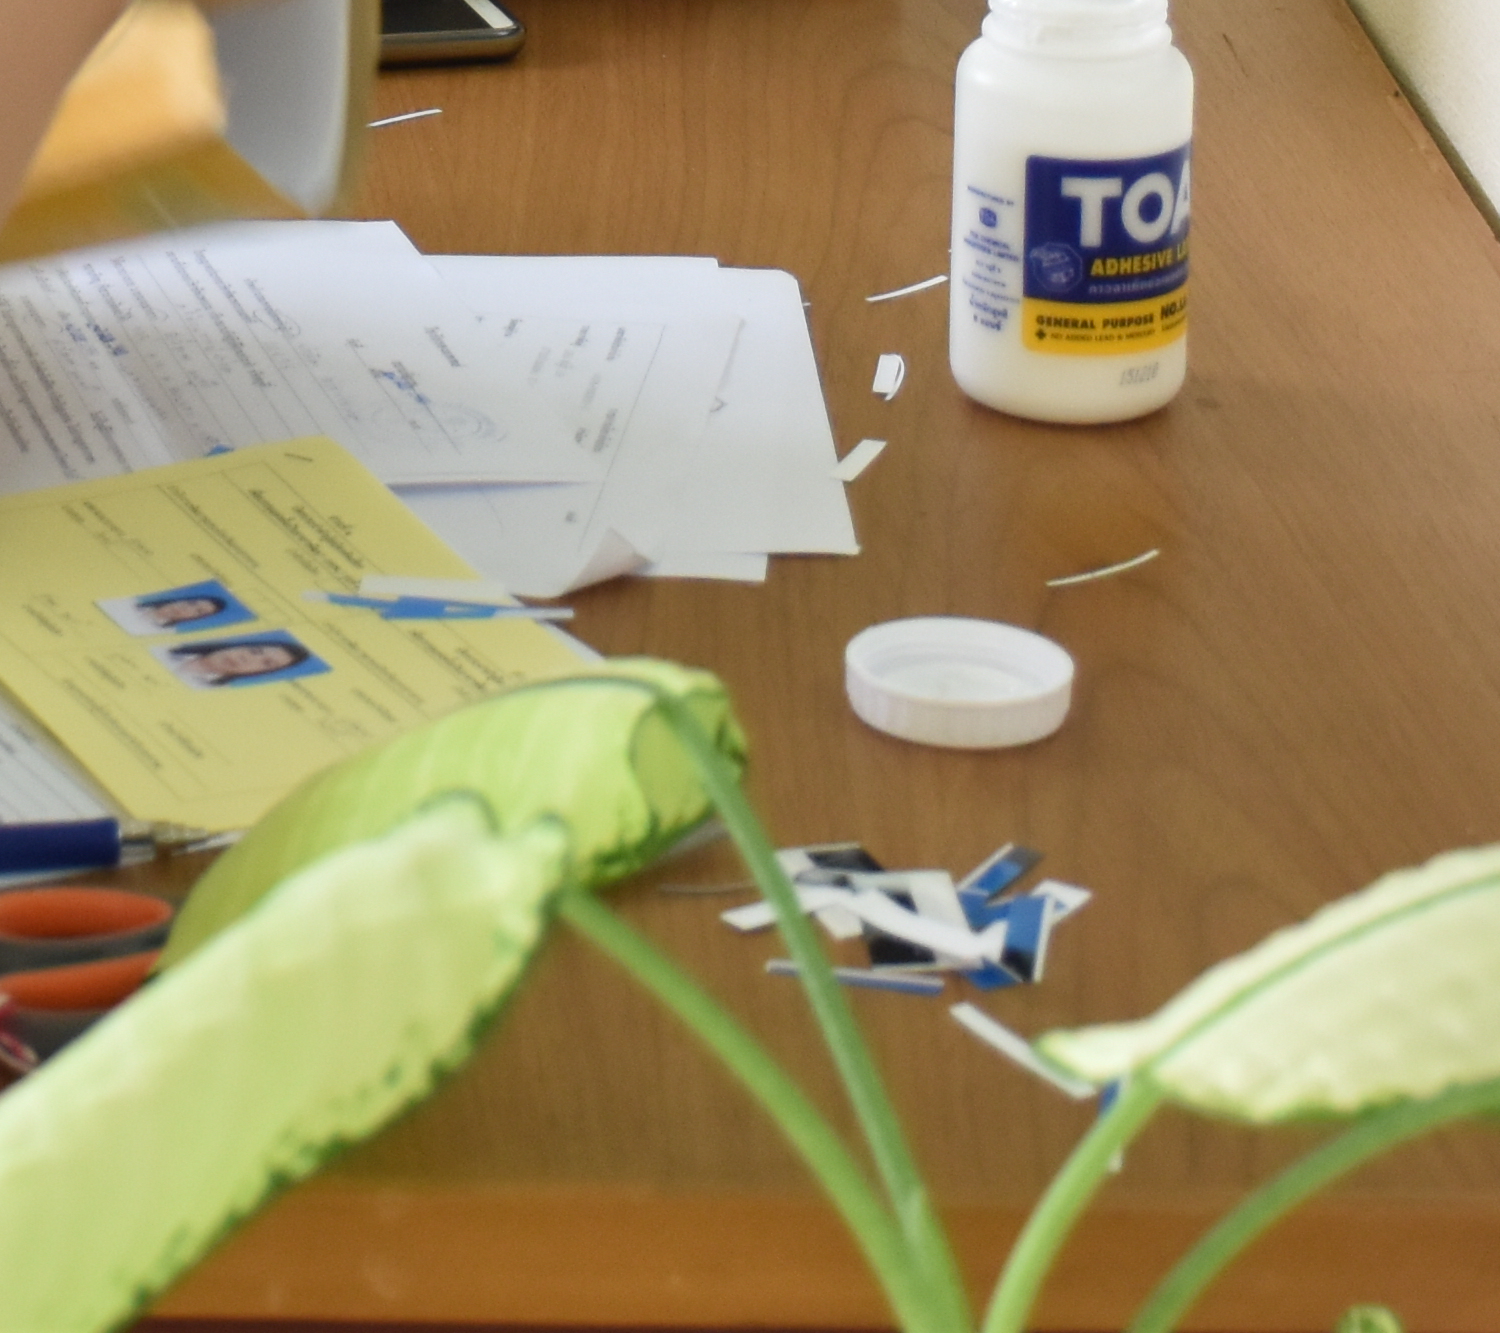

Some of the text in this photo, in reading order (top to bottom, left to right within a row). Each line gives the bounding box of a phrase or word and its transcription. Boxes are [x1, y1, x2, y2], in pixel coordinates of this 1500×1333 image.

[1090, 248, 1173, 276] ADHESIVE
[1036, 315, 1095, 329] GENERAL
[1102, 313, 1154, 328] PURPOSE
